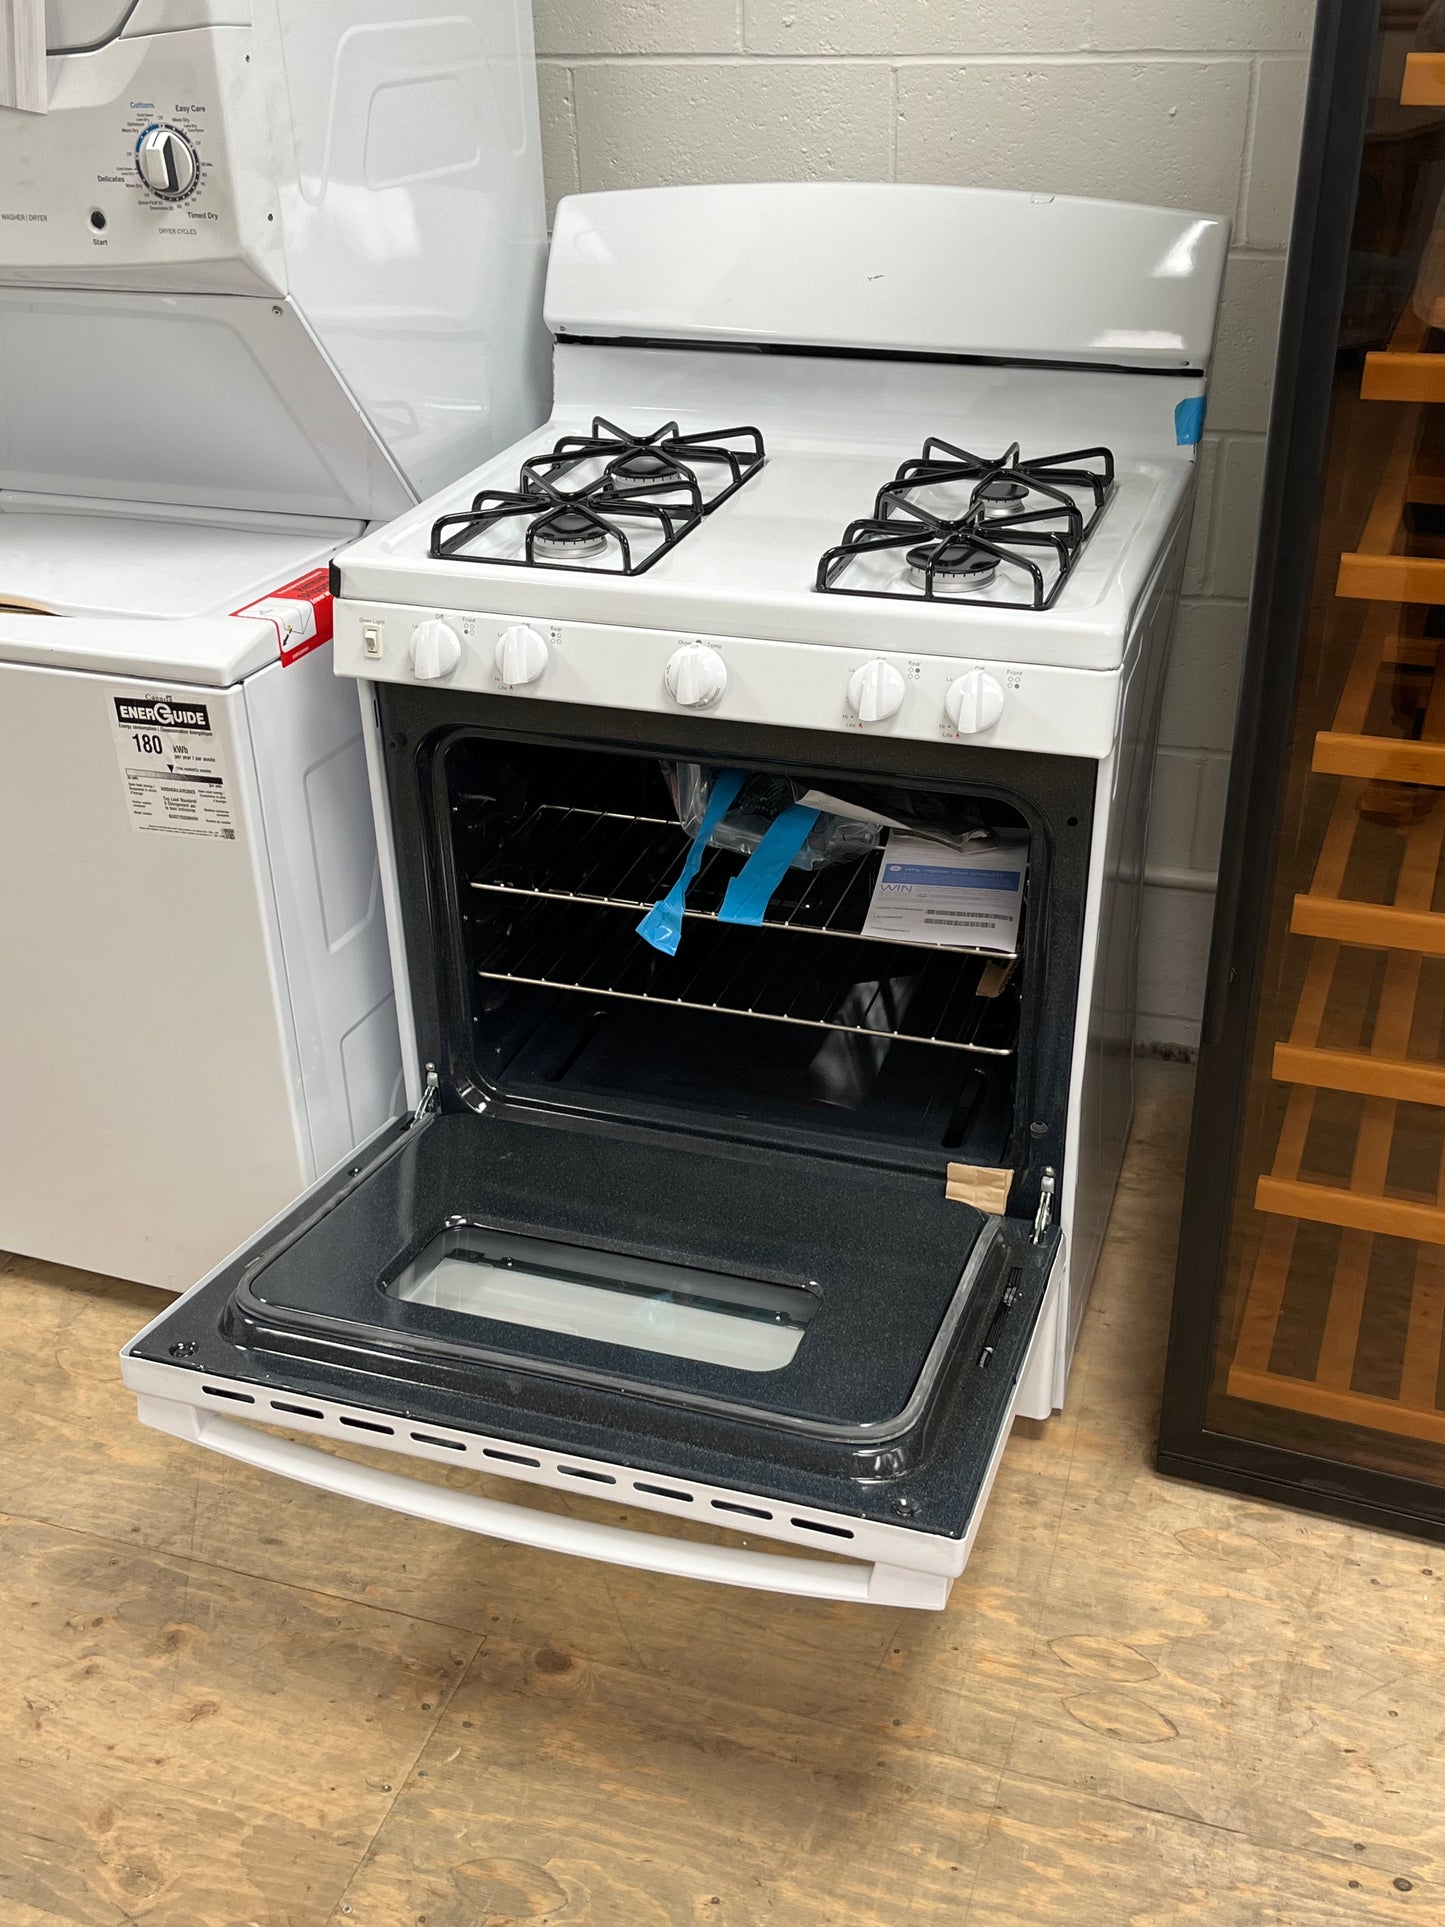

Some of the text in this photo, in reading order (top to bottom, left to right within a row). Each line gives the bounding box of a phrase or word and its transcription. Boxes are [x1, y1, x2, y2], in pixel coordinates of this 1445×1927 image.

[120, 703, 206, 725] ENERGUIDE
[132, 734, 163, 754] 180
[173, 745, 189, 754] kWh
[881, 884, 912, 892] WIN
